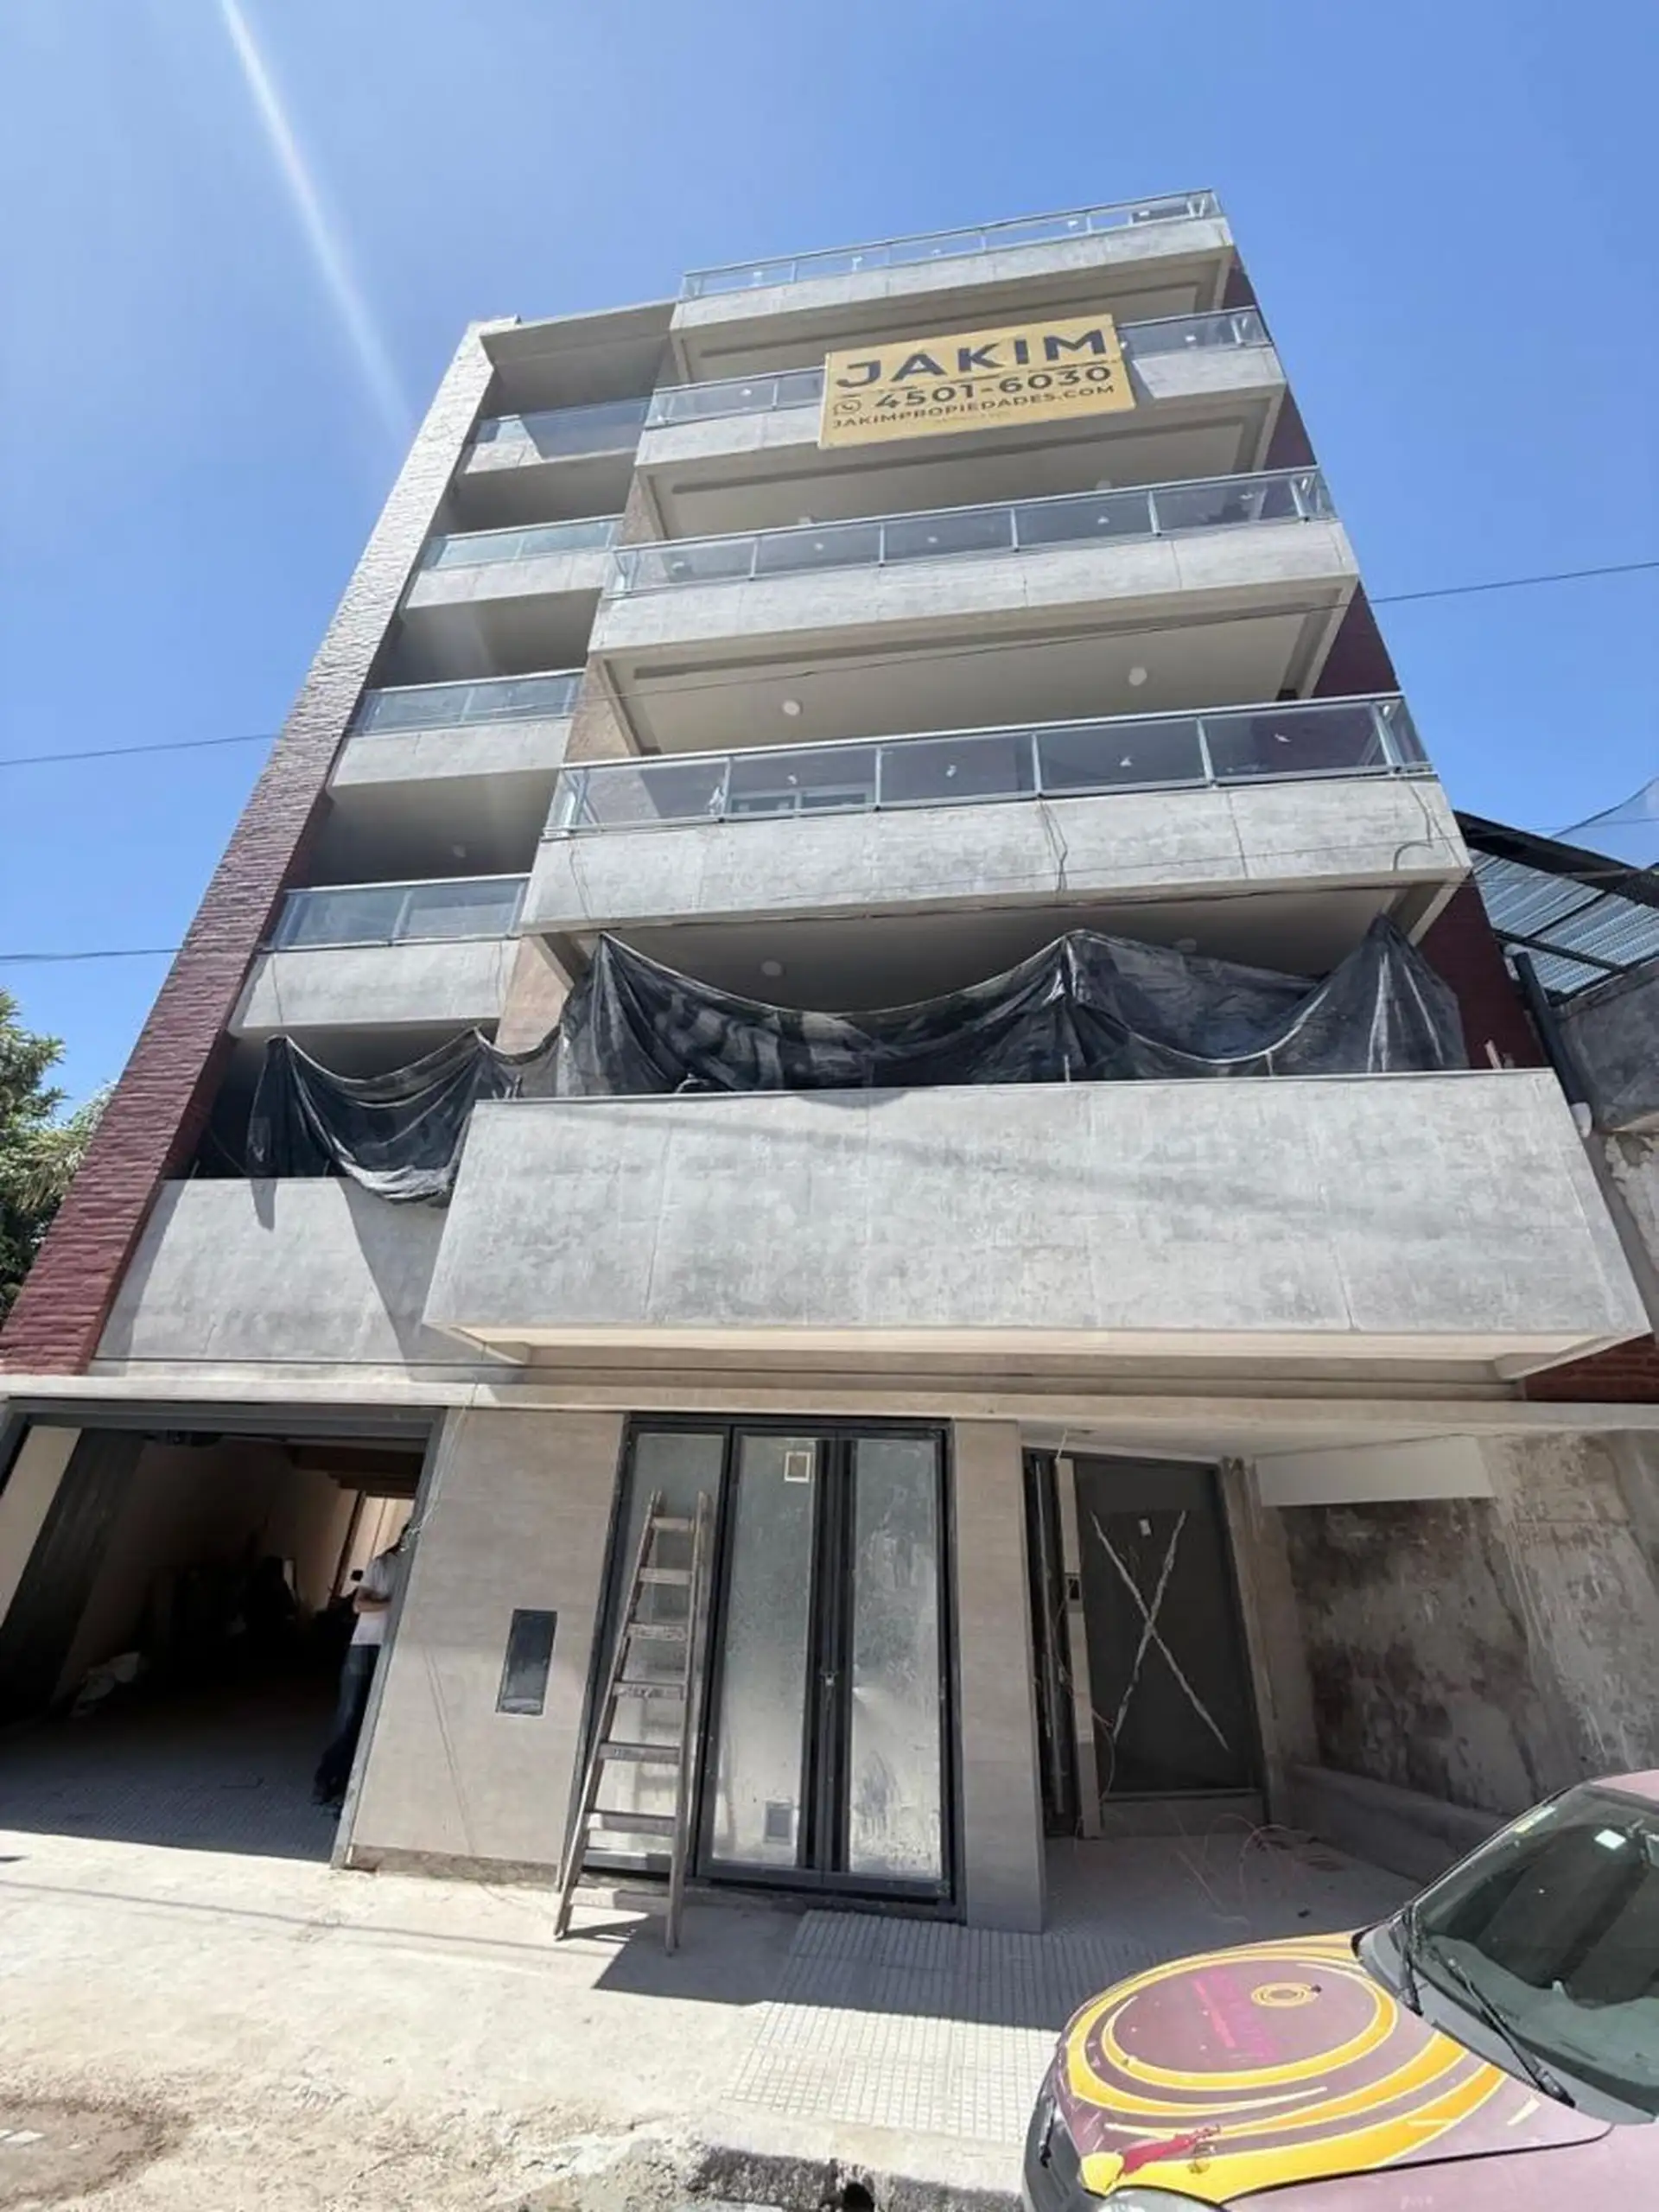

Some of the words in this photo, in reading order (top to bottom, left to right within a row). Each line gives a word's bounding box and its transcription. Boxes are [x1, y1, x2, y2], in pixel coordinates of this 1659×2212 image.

[836, 329, 1106, 388] JAKIM
[832, 385, 1114, 429] JAKIMPROPIEDADES.COM
[874, 366, 1111, 409] 4501-6030
